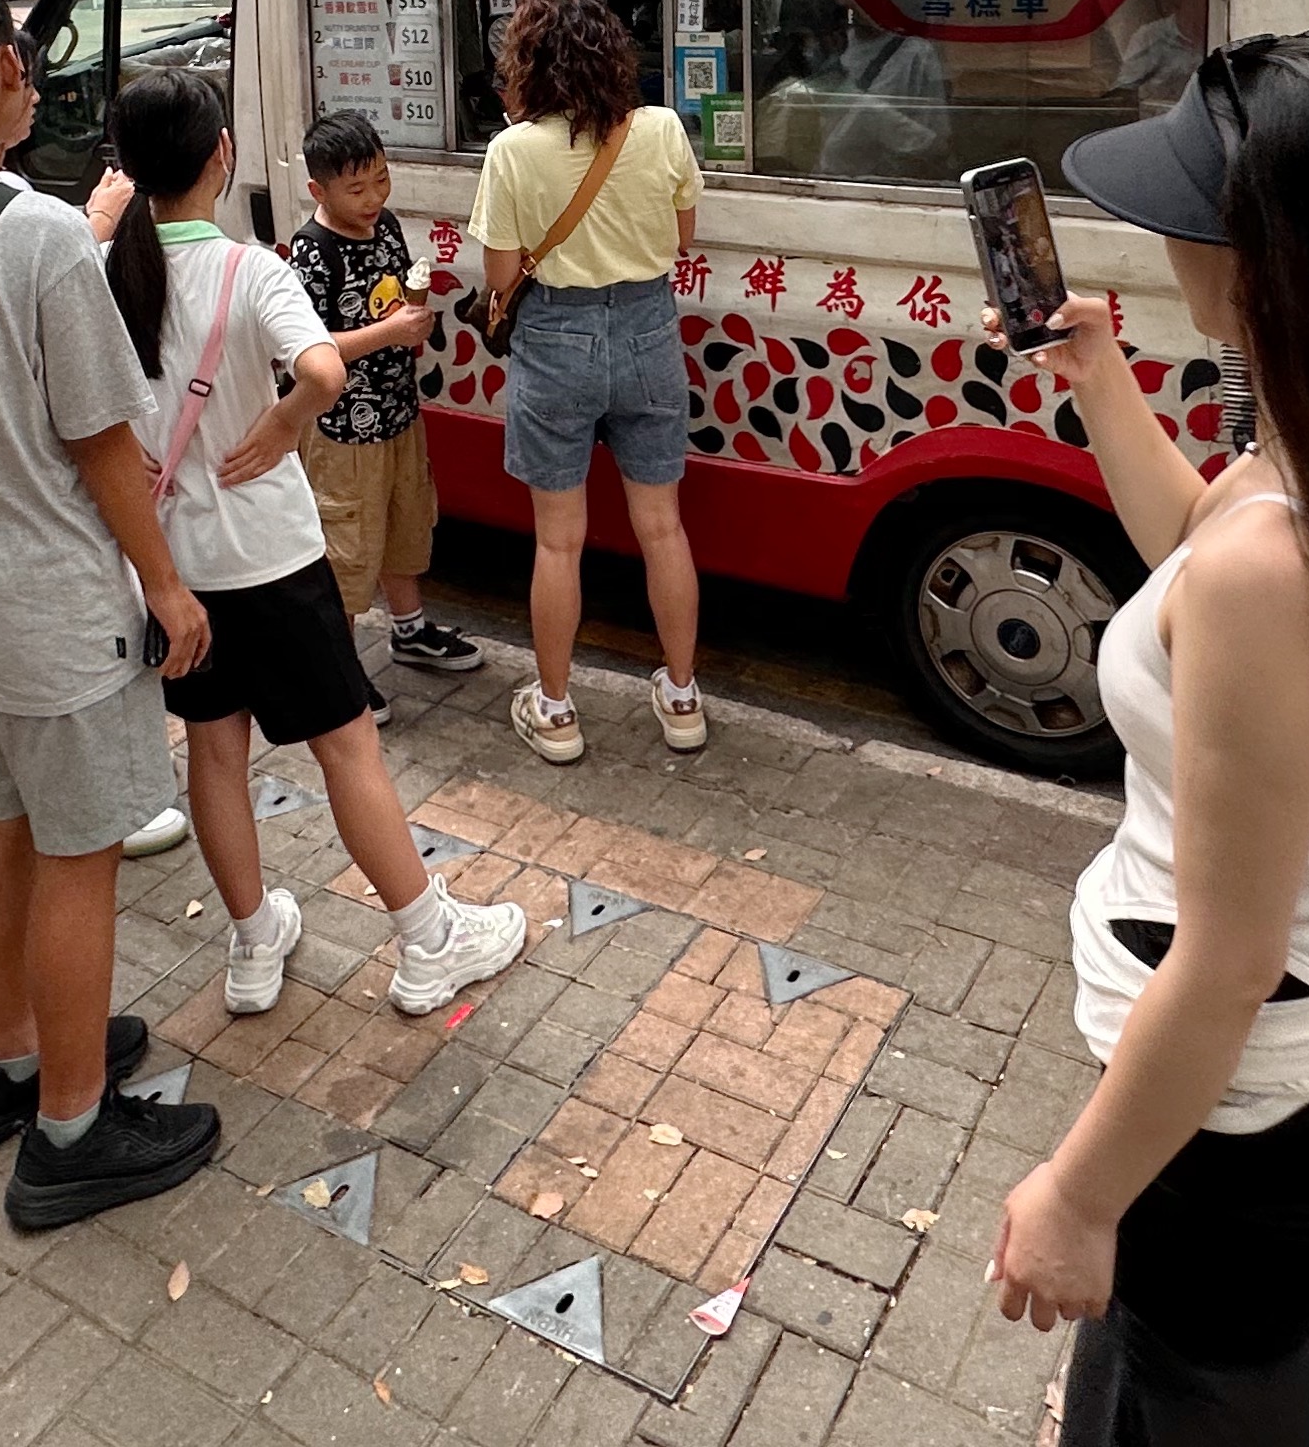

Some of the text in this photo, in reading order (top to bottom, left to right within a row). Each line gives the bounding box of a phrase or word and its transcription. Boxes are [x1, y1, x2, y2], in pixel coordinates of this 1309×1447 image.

[401, 27, 430, 46] $12
[405, 69, 433, 88] $10
[406, 102, 434, 120] $10
